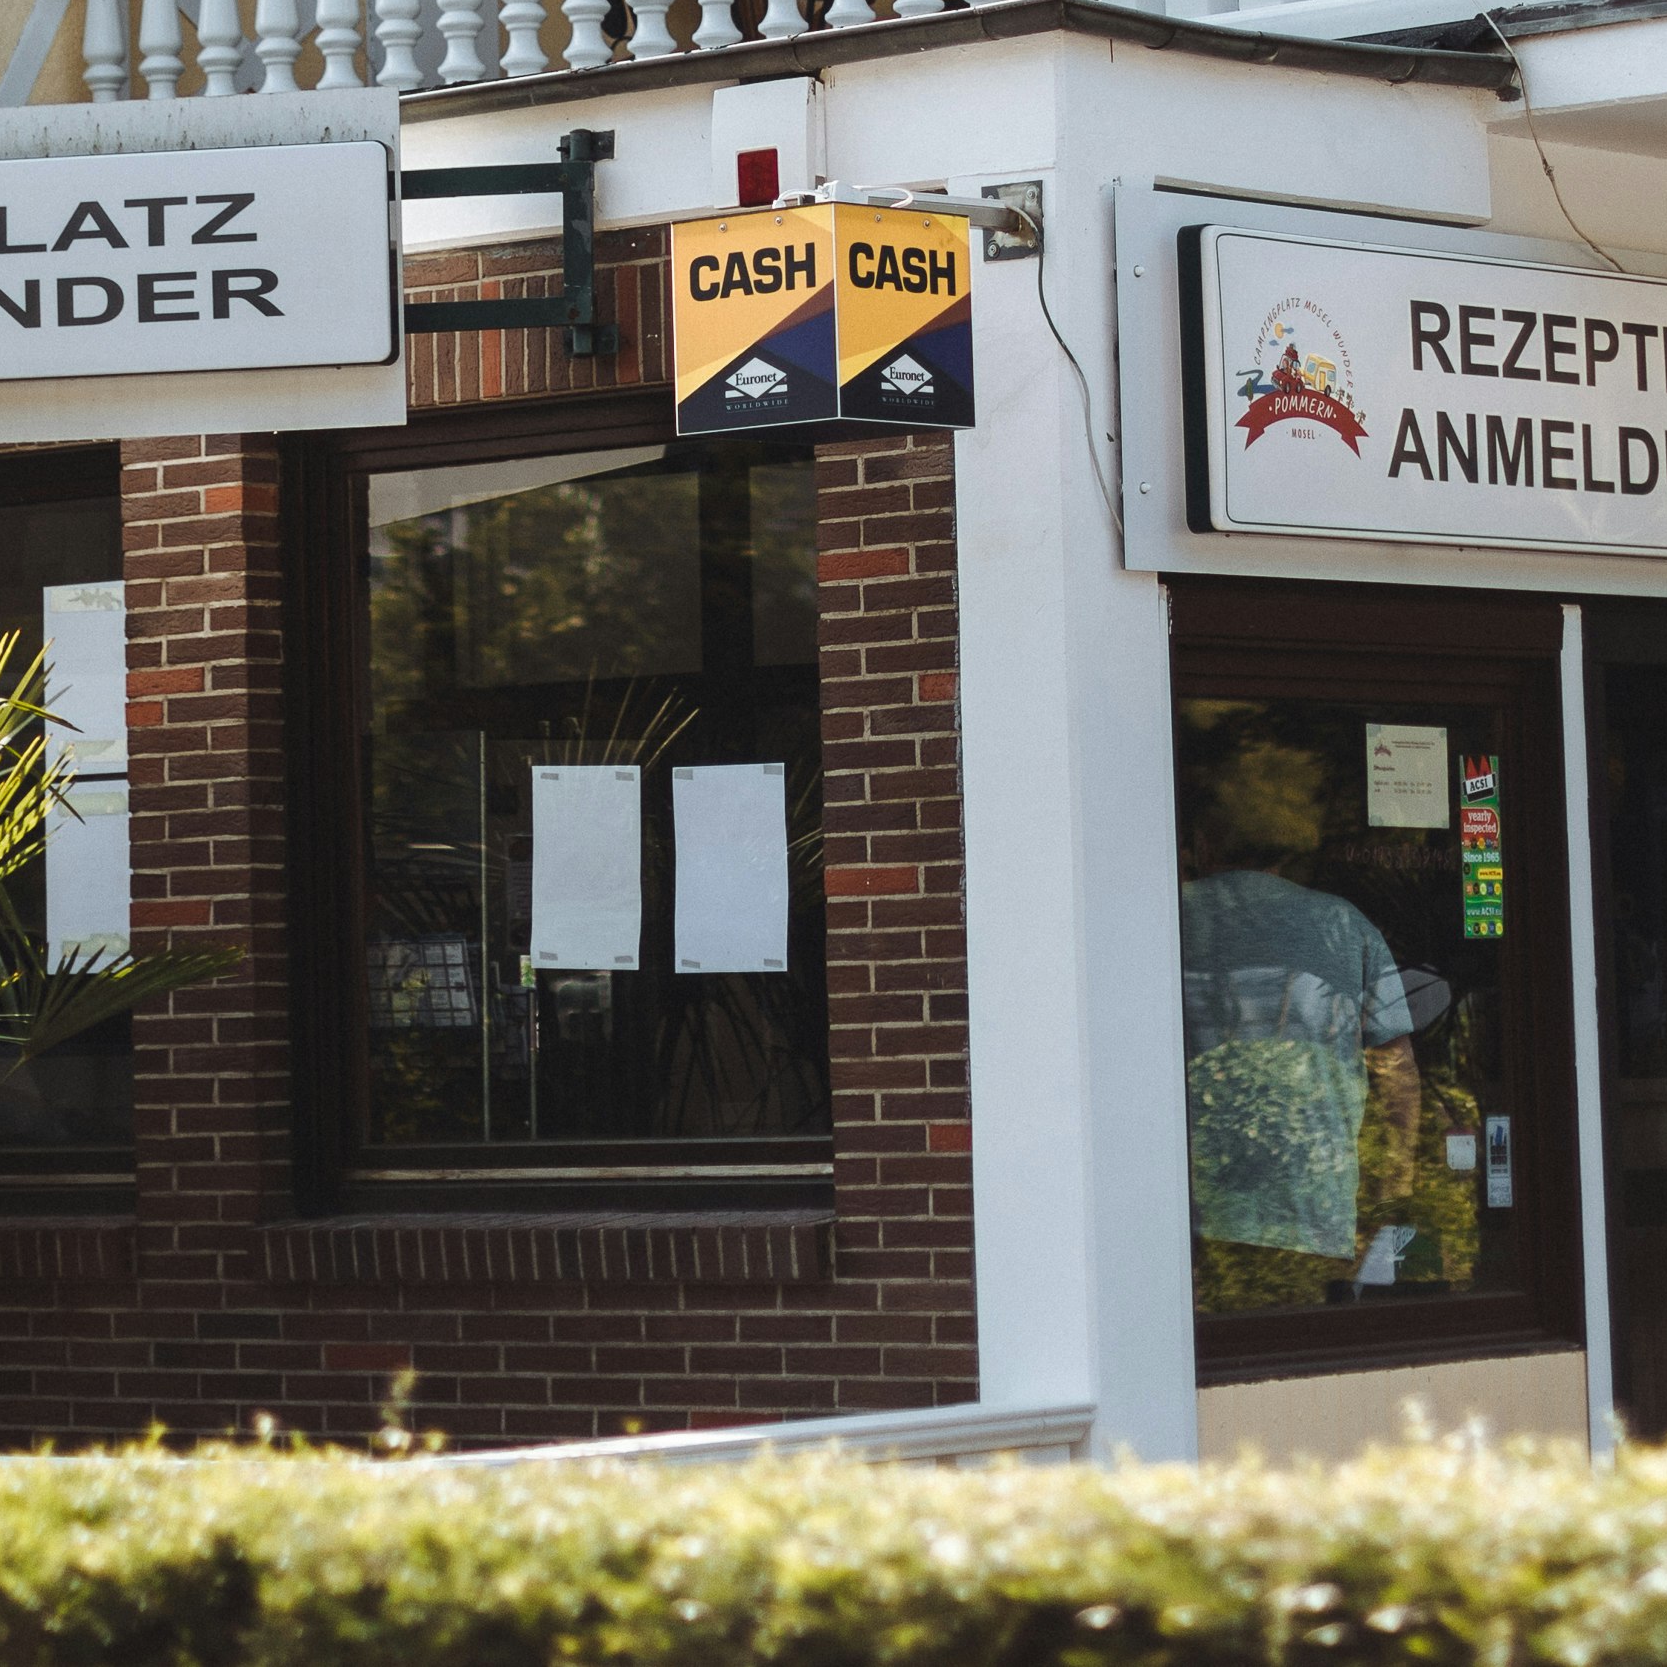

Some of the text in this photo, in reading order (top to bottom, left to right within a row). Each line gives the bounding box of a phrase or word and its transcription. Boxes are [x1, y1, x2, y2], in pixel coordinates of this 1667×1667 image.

[689, 242, 816, 302] CASH
[848, 241, 956, 296] CASH
[1253, 297, 1353, 389] CAMPINGPLATZ MOSEL WUNDER
[735, 372, 777, 386] Euronet
[889, 366, 925, 382] Euronet
[725, 398, 789, 411] WORLDWIDE
[882, 397, 934, 406] WORLDWIDE
[1274, 396, 1334, 418] POMMERN
[1291, 428, 1316, 440] MOSEL
[1470, 778, 1489, 791] ACSI
[1468, 809, 1492, 823] yearly
[1464, 821, 1497, 835] inspected
[1463, 851, 1483, 862] Since
